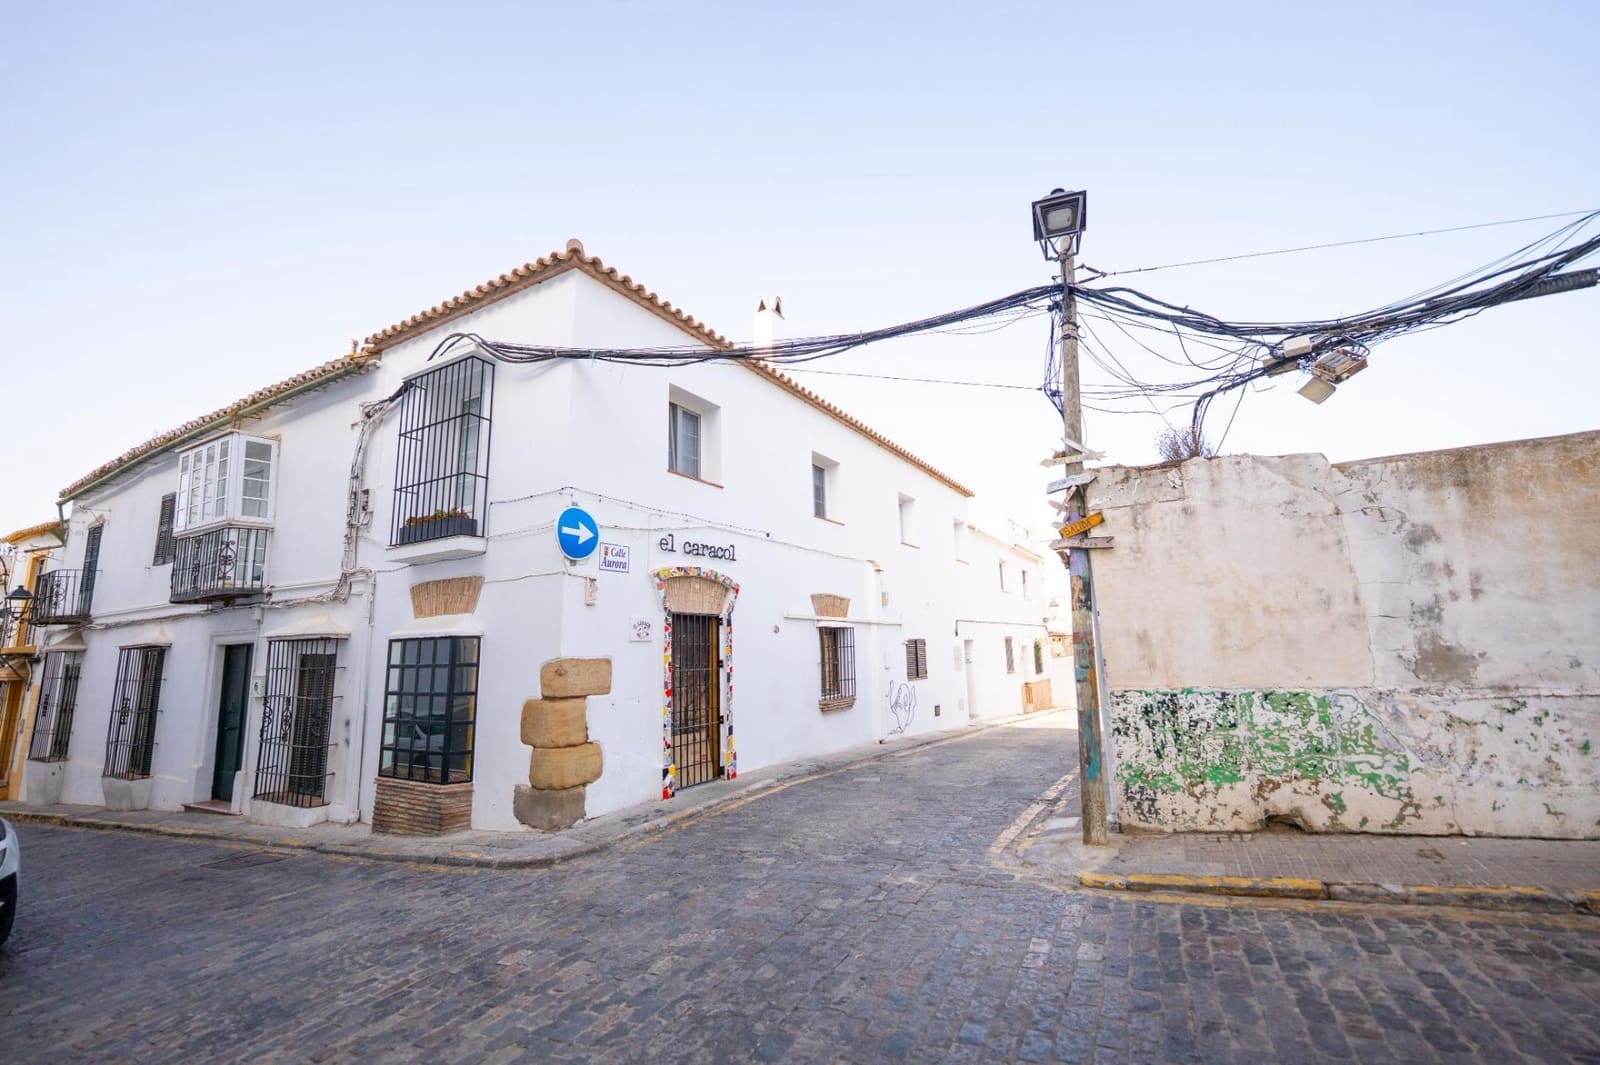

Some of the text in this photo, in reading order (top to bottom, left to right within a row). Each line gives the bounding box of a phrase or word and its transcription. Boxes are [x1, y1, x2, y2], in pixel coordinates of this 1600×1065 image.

[611, 548, 626, 558] Calle
[659, 533, 737, 561] el caracol
[600, 557, 627, 569] Aurora
